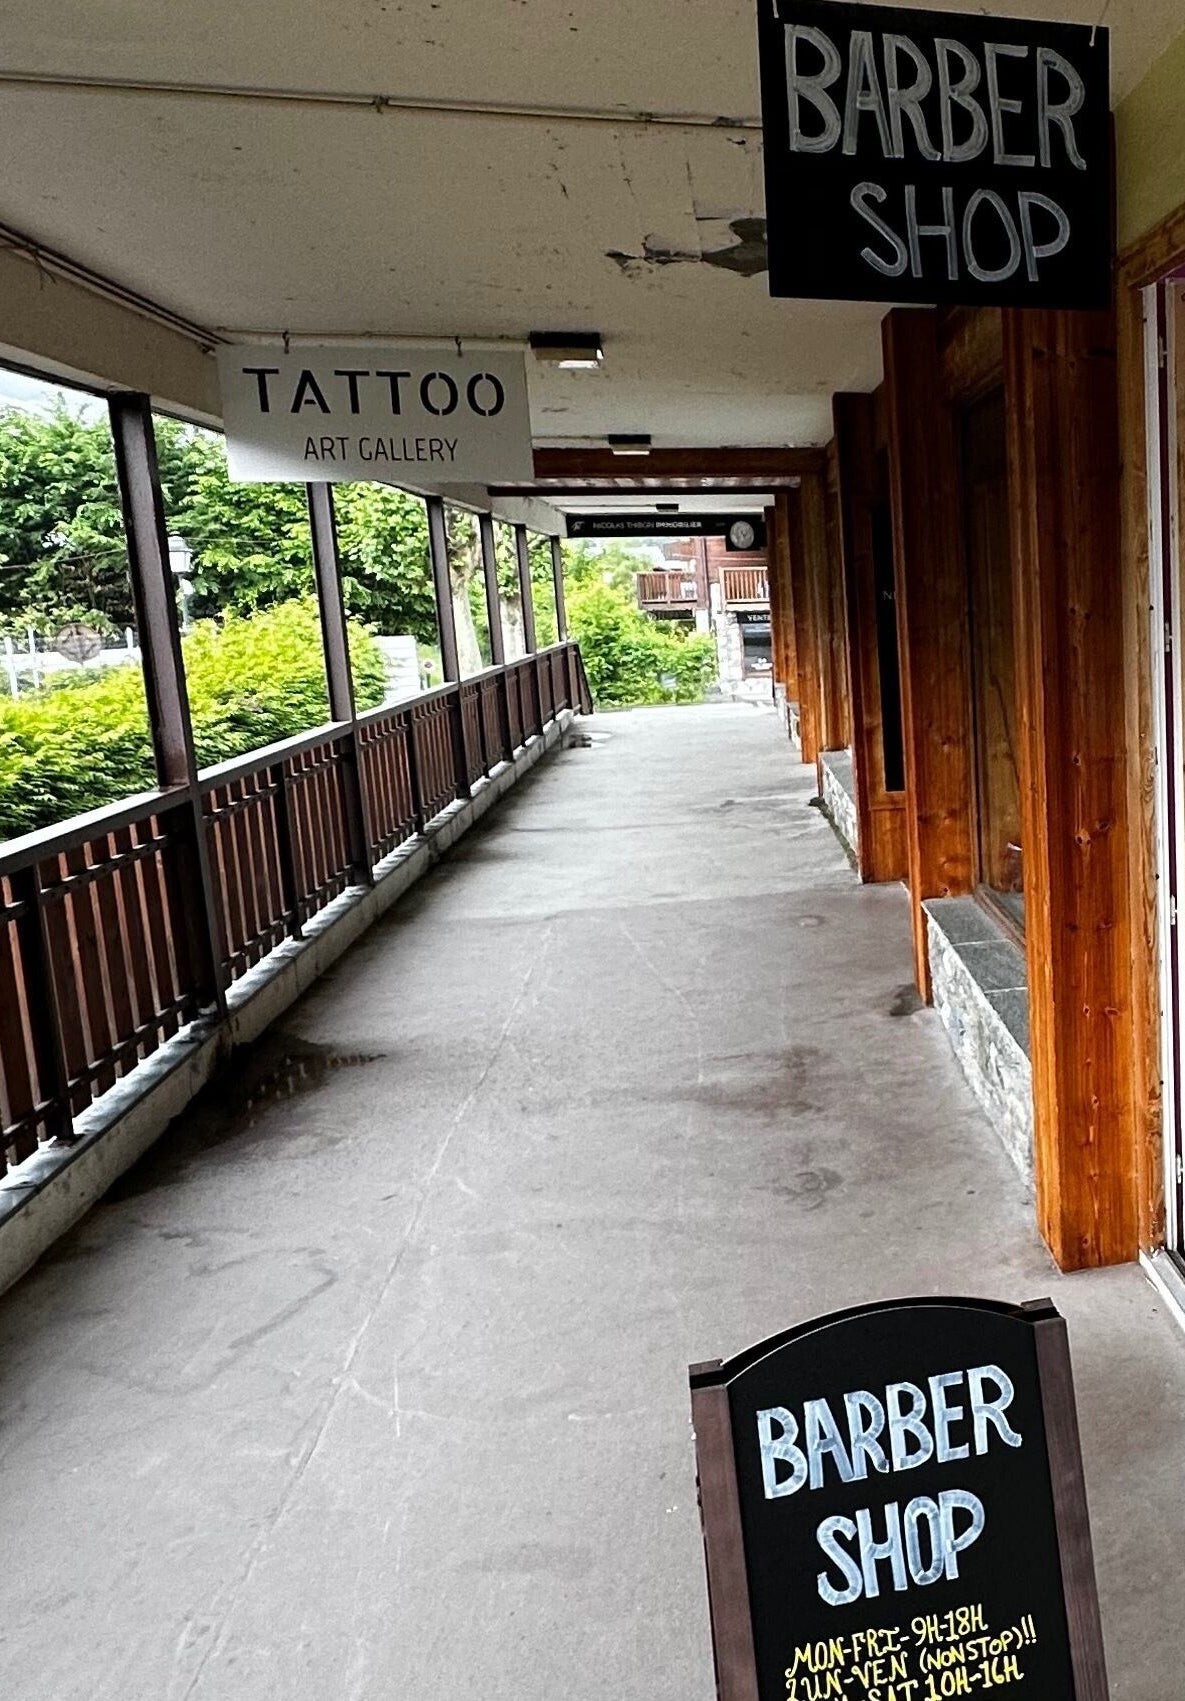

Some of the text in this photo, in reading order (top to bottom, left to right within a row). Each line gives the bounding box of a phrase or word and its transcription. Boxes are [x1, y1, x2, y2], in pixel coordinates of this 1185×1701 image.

[784, 23, 1087, 171] BARBER
[850, 181, 1070, 282] SHOP
[242, 367, 505, 417] TATTOO
[303, 436, 459, 462] ART GALLERY
[756, 1364, 1022, 1500] BARBER
[816, 1488, 986, 1606] SHOP
